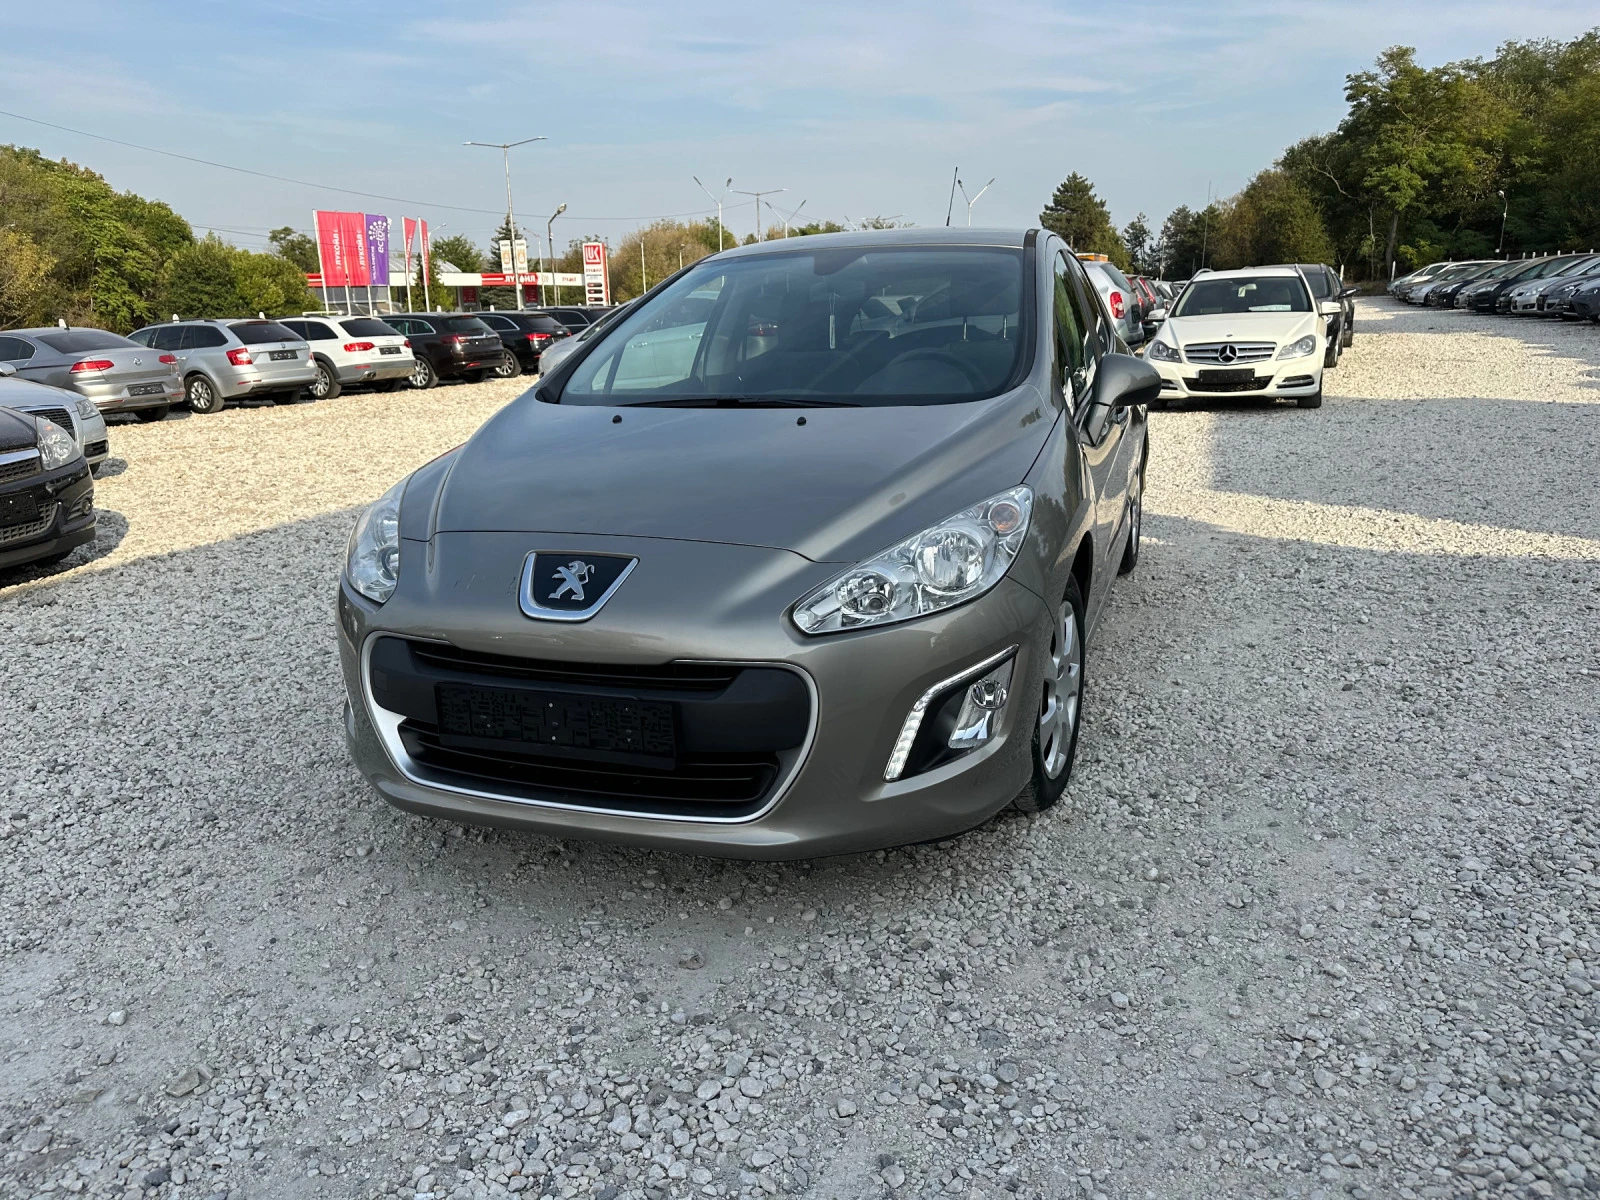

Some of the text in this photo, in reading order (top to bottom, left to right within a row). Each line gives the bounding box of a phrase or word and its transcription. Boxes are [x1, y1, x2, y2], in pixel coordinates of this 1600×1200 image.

[333, 233, 342, 266] ЛУКОЙЛ
[356, 233, 366, 267] ЛУКОЙЛ
[375, 230, 385, 254] ecto
